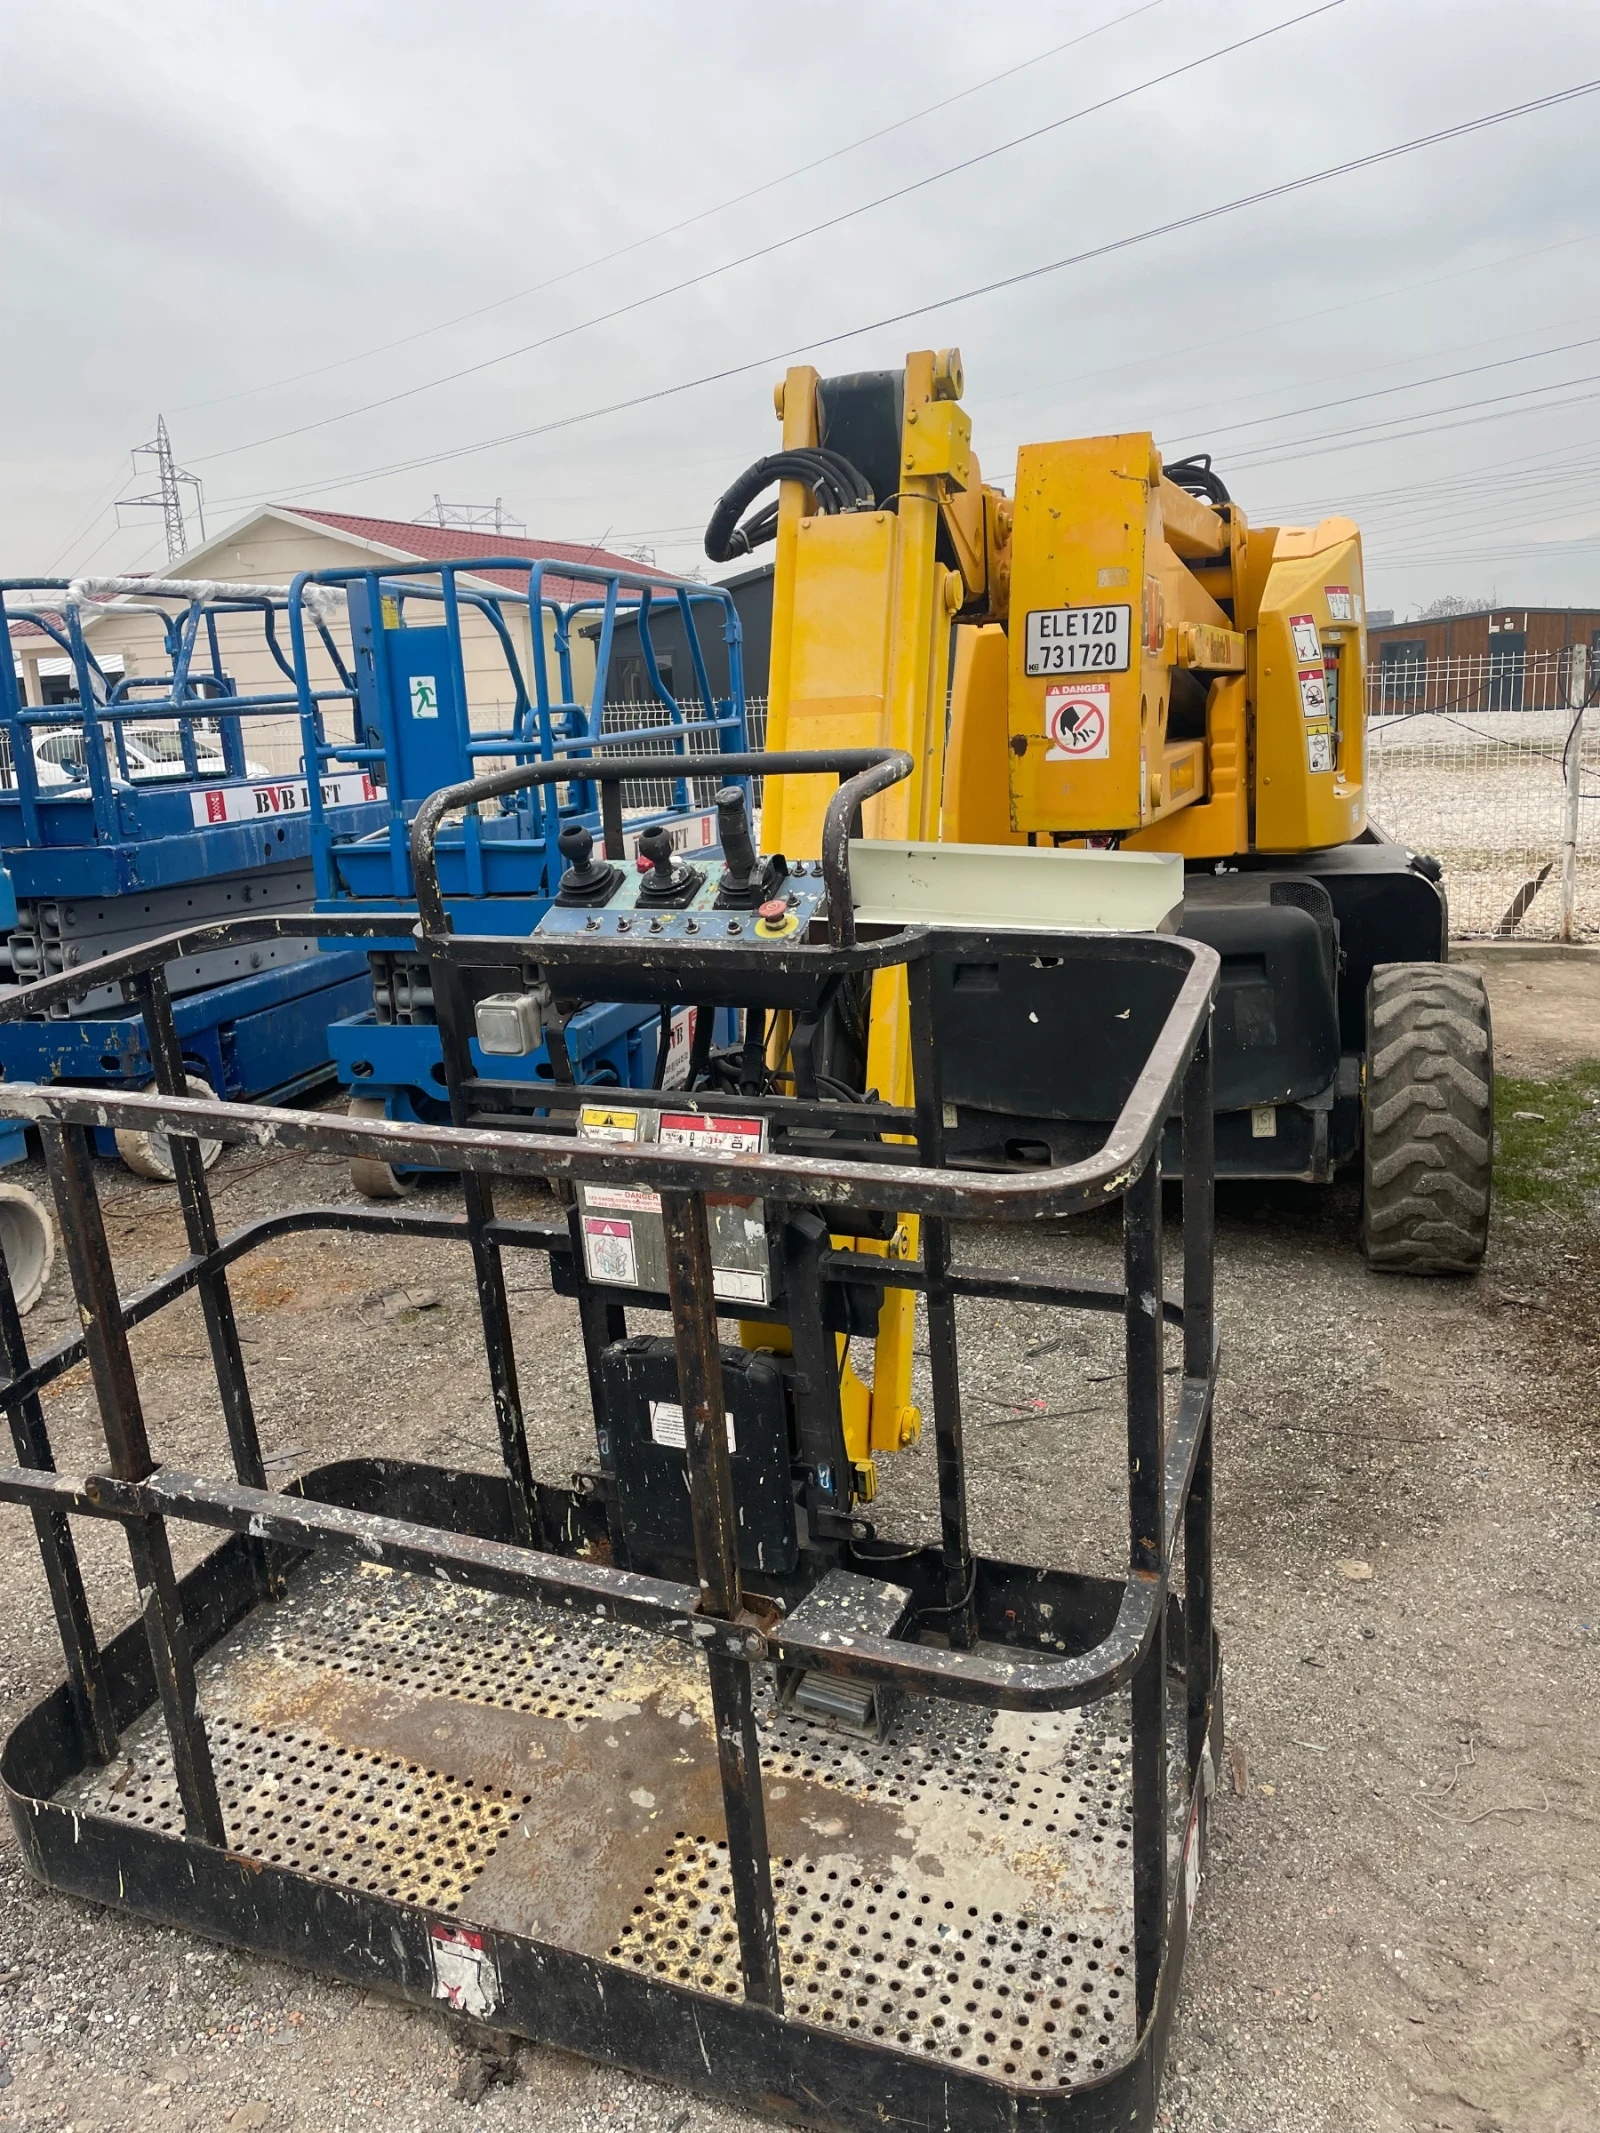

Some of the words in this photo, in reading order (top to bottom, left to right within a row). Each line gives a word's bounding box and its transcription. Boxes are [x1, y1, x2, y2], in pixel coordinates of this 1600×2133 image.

[1040, 611, 1117, 638] ELE12D
[1040, 641, 1116, 669] 731720
[1062, 684, 1106, 694] DANGER
[252, 785, 295, 813] BVB
[301, 784, 341, 808] LFT
[624, 1191, 659, 1201] DANGER
